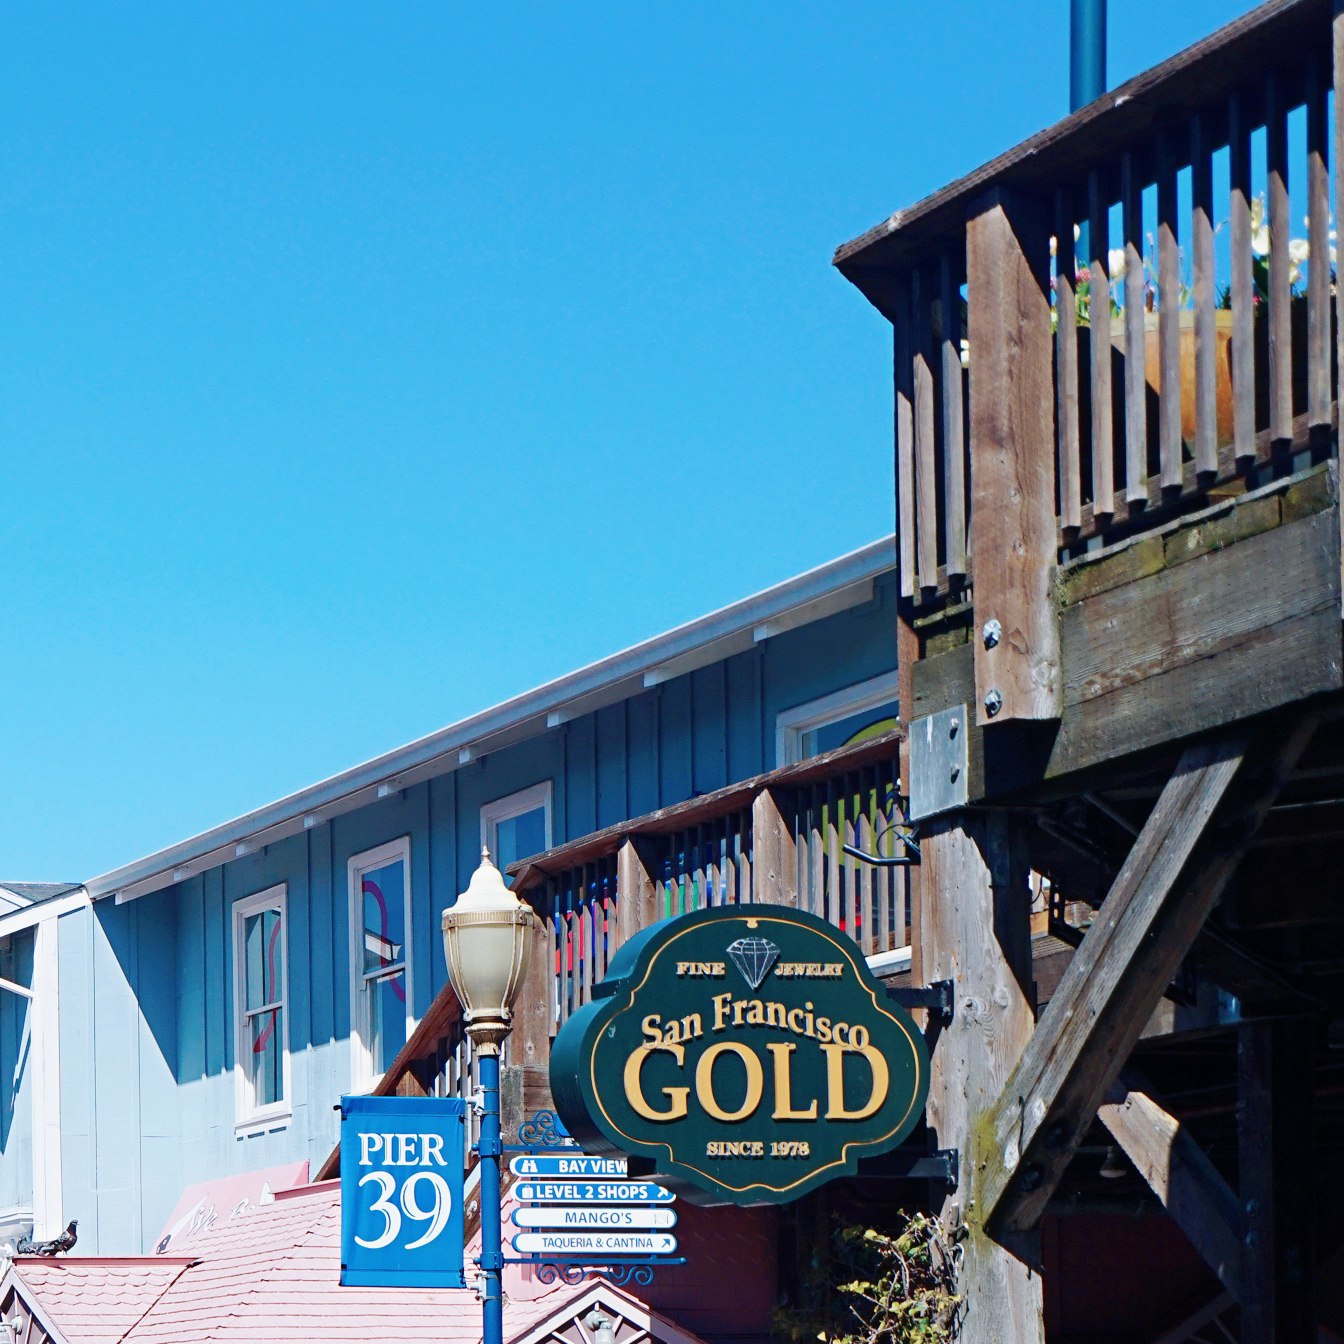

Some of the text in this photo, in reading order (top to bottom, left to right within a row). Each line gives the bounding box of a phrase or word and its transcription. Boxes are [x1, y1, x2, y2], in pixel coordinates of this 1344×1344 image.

[675, 962, 844, 977] FINE JEWELRY
[641, 992, 870, 1050] San Francisco
[623, 1041, 889, 1122] GOLD
[357, 1132, 448, 1166] PIER
[706, 1142, 810, 1157] SINCE 1978
[558, 1159, 587, 1173] BAY
[536, 1185, 648, 1199] LEVEL 2 SHOPS
[354, 1171, 452, 1250] 39
[564, 1211, 633, 1225] MANGO'S
[542, 1237, 654, 1250] TAQUERIA & CANTINA
